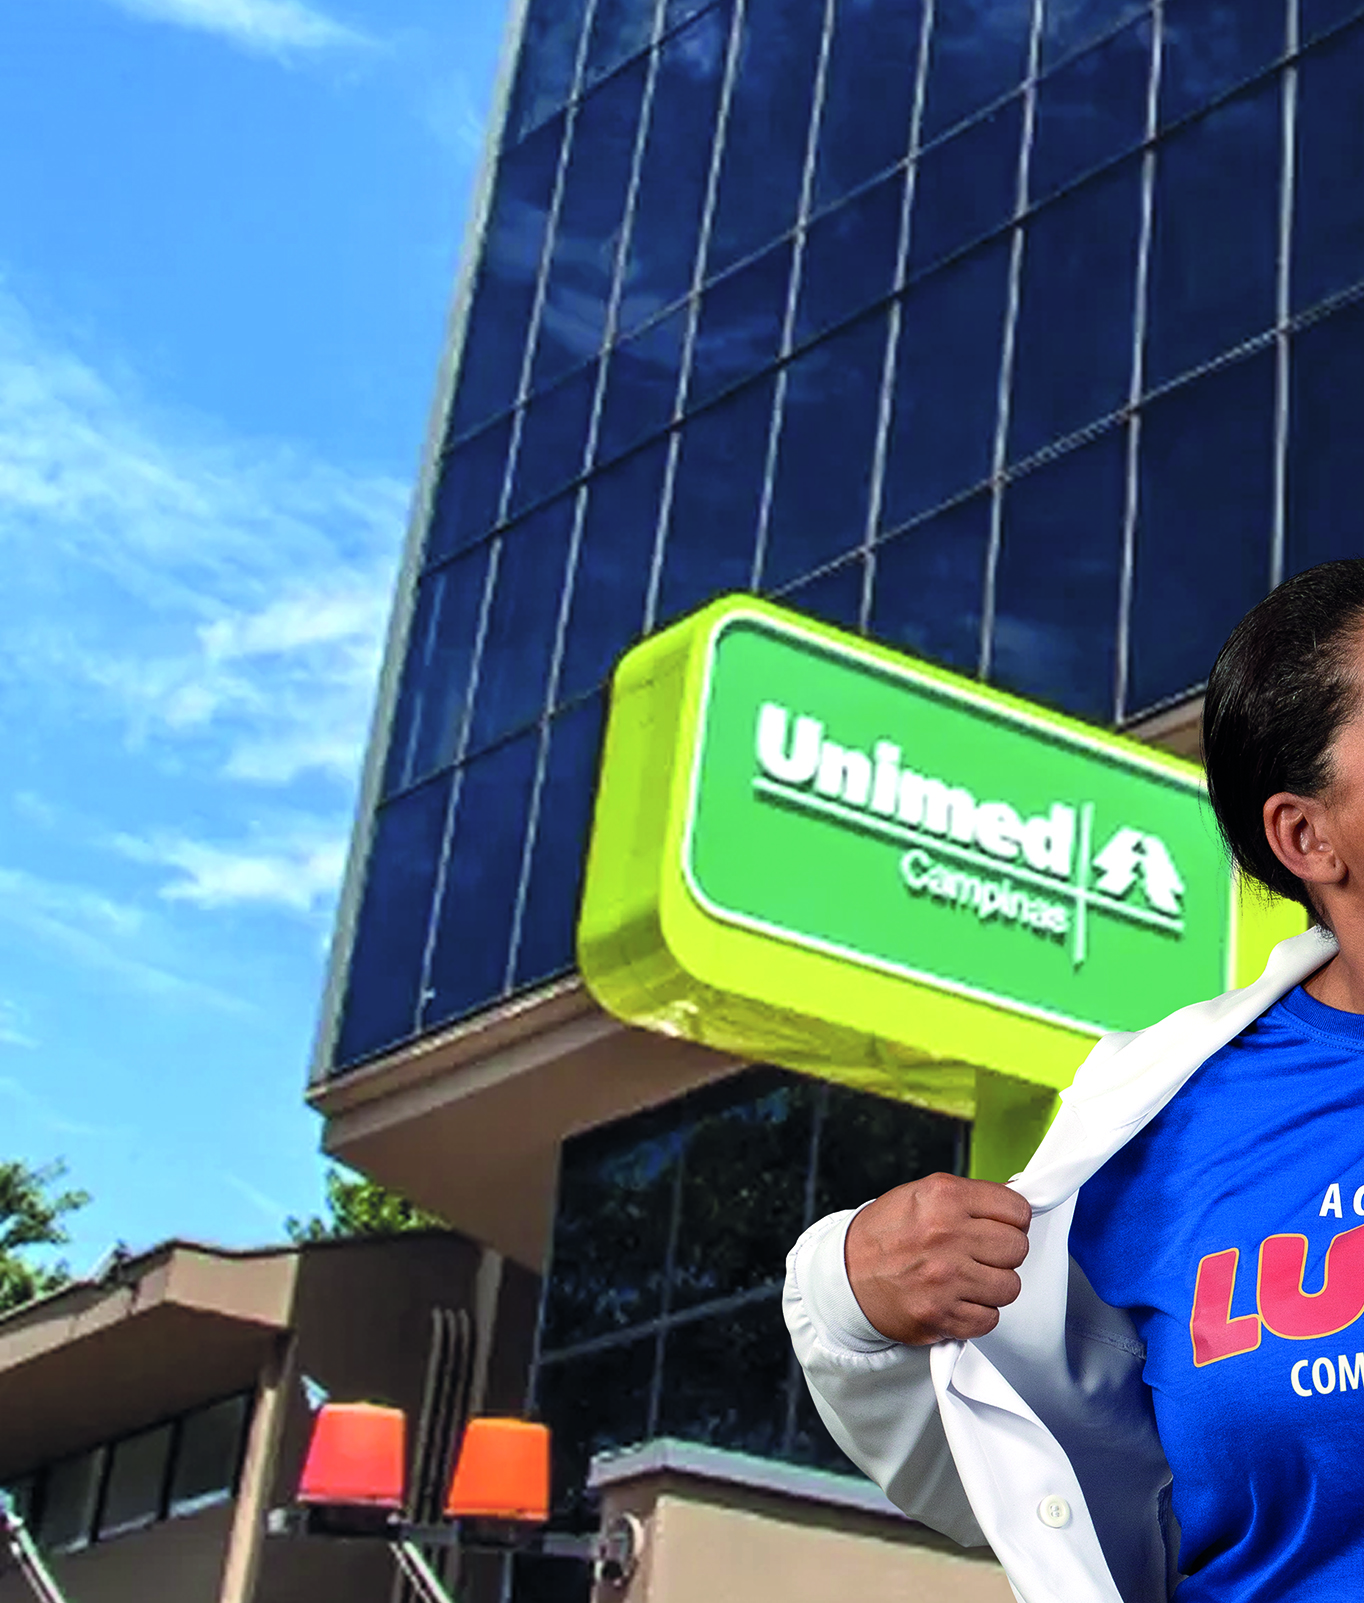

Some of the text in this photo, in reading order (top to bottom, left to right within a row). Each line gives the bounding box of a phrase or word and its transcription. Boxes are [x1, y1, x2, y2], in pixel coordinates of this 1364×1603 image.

[755, 700, 1077, 879] Unimed
[900, 850, 1071, 935] Campinas
[1319, 1182, 1344, 1219] A
